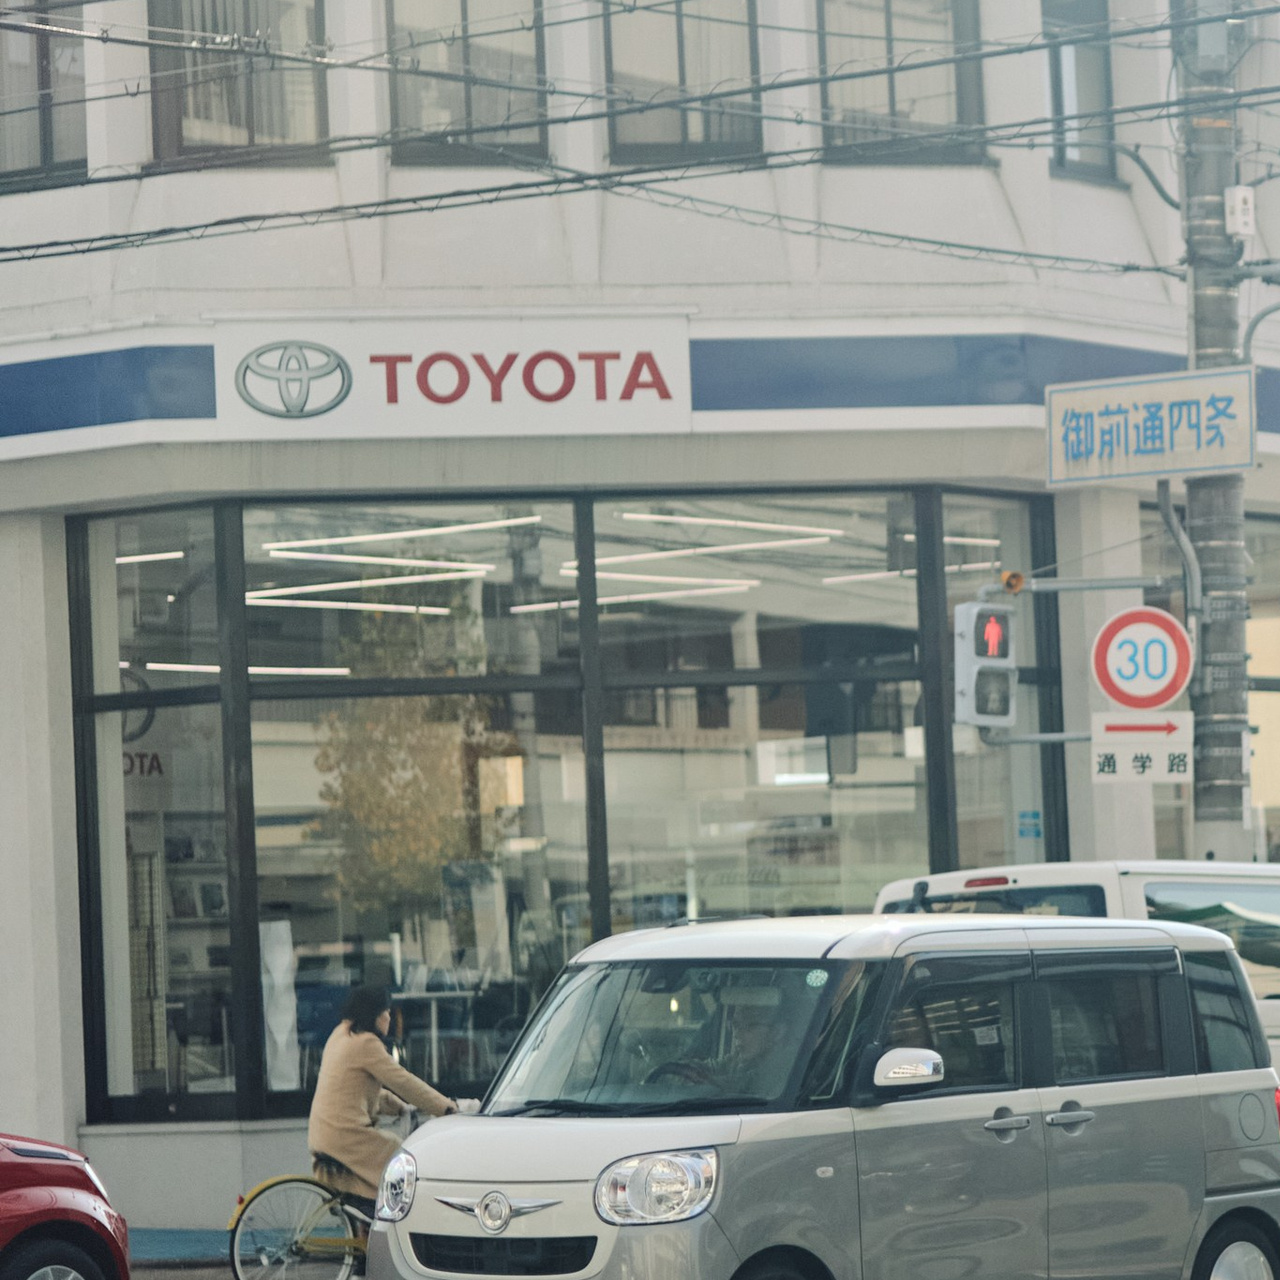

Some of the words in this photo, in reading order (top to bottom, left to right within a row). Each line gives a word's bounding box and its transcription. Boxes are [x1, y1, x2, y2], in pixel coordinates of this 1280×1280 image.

[369, 350, 673, 405] TOYOTA
[1061, 393, 1237, 462] 御前通四条
[1115, 638, 1168, 681] 30
[1096, 752, 1188, 776] 通学路
